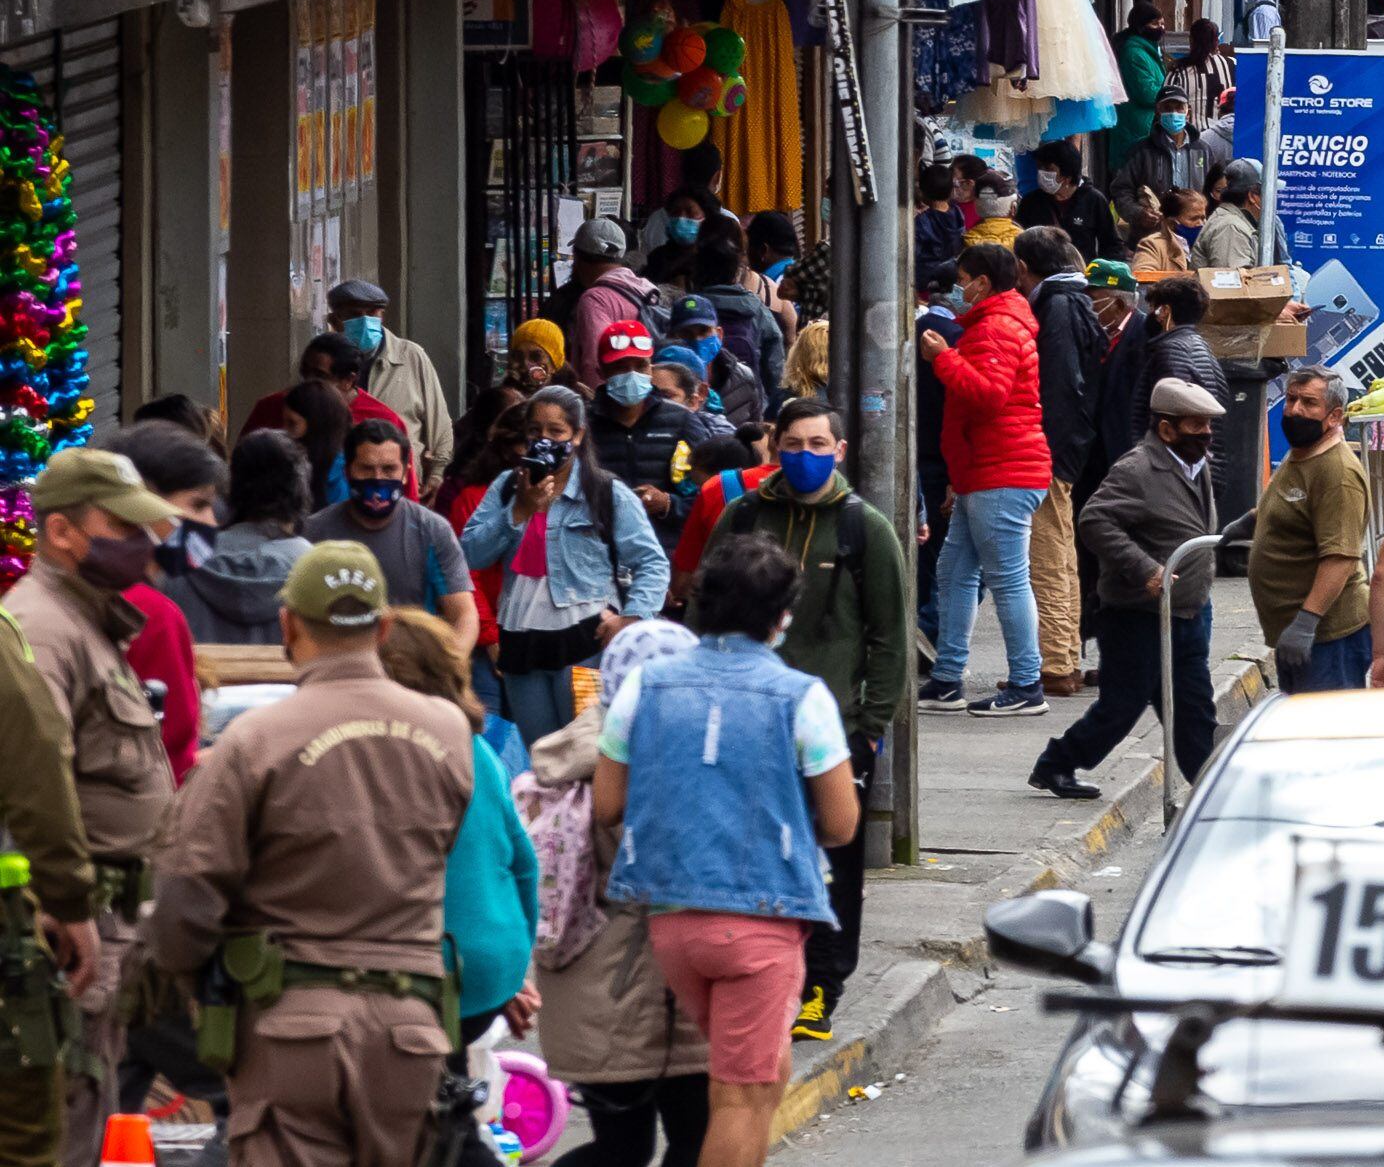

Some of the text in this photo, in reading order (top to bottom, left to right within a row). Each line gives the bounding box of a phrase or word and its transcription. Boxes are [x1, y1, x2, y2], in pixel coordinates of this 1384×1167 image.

[1280, 97, 1374, 108] ECTRO STORE
[1279, 134, 1369, 152] ERVICIO
[1277, 170, 1317, 178] MARTPHONE
